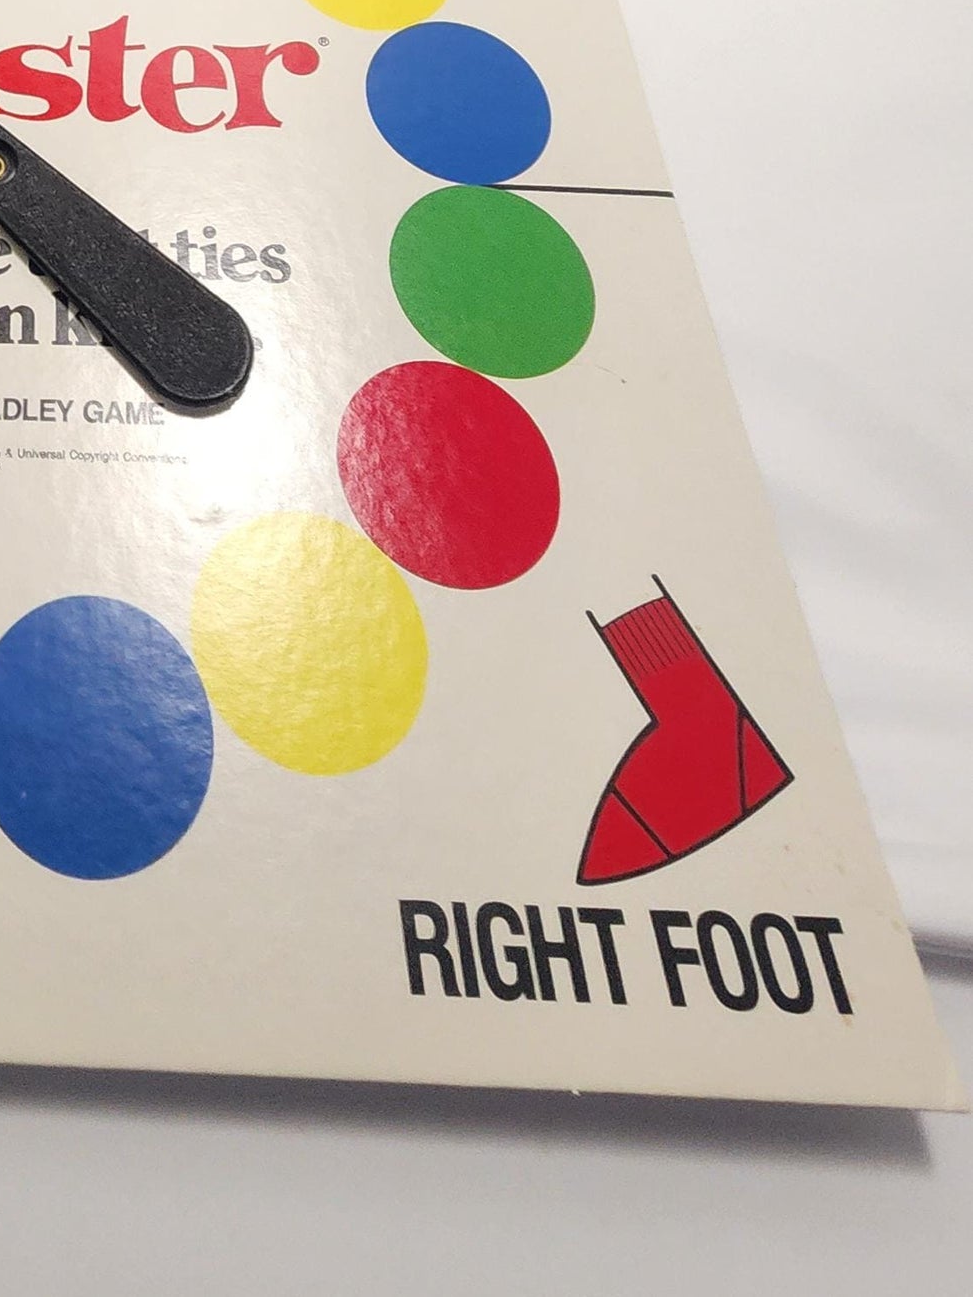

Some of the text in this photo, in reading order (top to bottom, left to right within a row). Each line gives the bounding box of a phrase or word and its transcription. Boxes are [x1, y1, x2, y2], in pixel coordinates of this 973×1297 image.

[169, 225, 292, 284] ties
[82, 399, 165, 426] GAME
[5, 448, 13, 458] &
[17, 448, 66, 460] Universal
[69, 449, 120, 464] Copyright
[398, 898, 854, 1015] RIGHT FOOT
